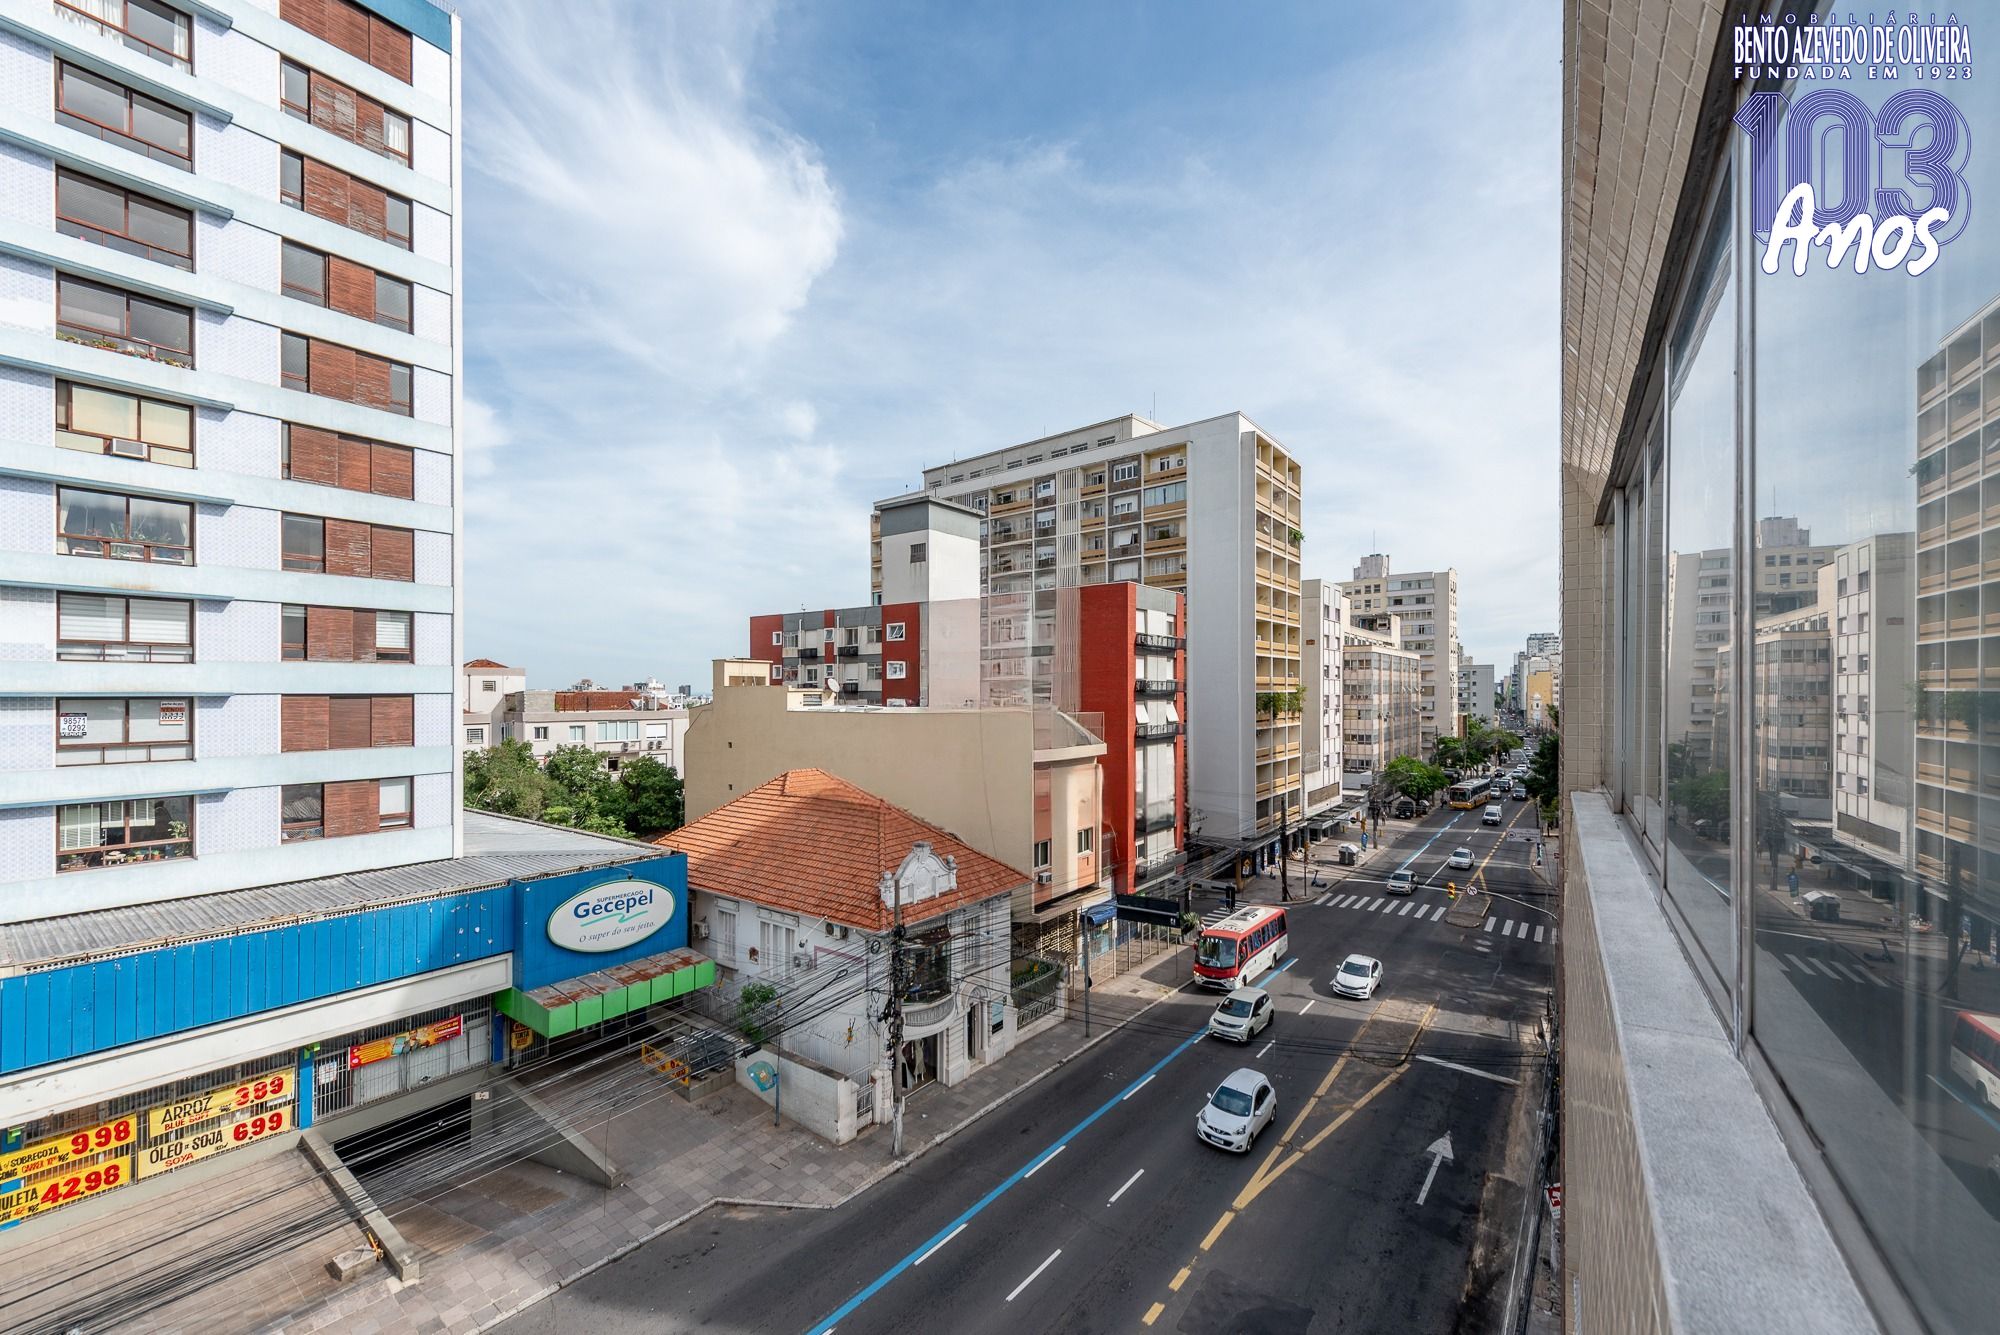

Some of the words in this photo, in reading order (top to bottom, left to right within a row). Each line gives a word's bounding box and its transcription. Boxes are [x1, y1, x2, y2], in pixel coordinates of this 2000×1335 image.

[67, 724, 86, 732] 0292
[573, 889, 653, 919] Gecepel
[596, 890, 644, 903] SUPERMERCADO
[588, 931, 610, 942] super
[612, 927, 621, 936] do
[623, 927, 635, 935] seu
[161, 1096, 214, 1125] ARROZ
[164, 1119, 185, 1131] BLUE
[149, 1142, 183, 1164] ÓLEO
[191, 1130, 223, 1151] SOJA
[10, 1146, 59, 1167] SOBRECOXA
[165, 1153, 194, 1167] SOYA
[0, 1187, 38, 1211] ULETA
